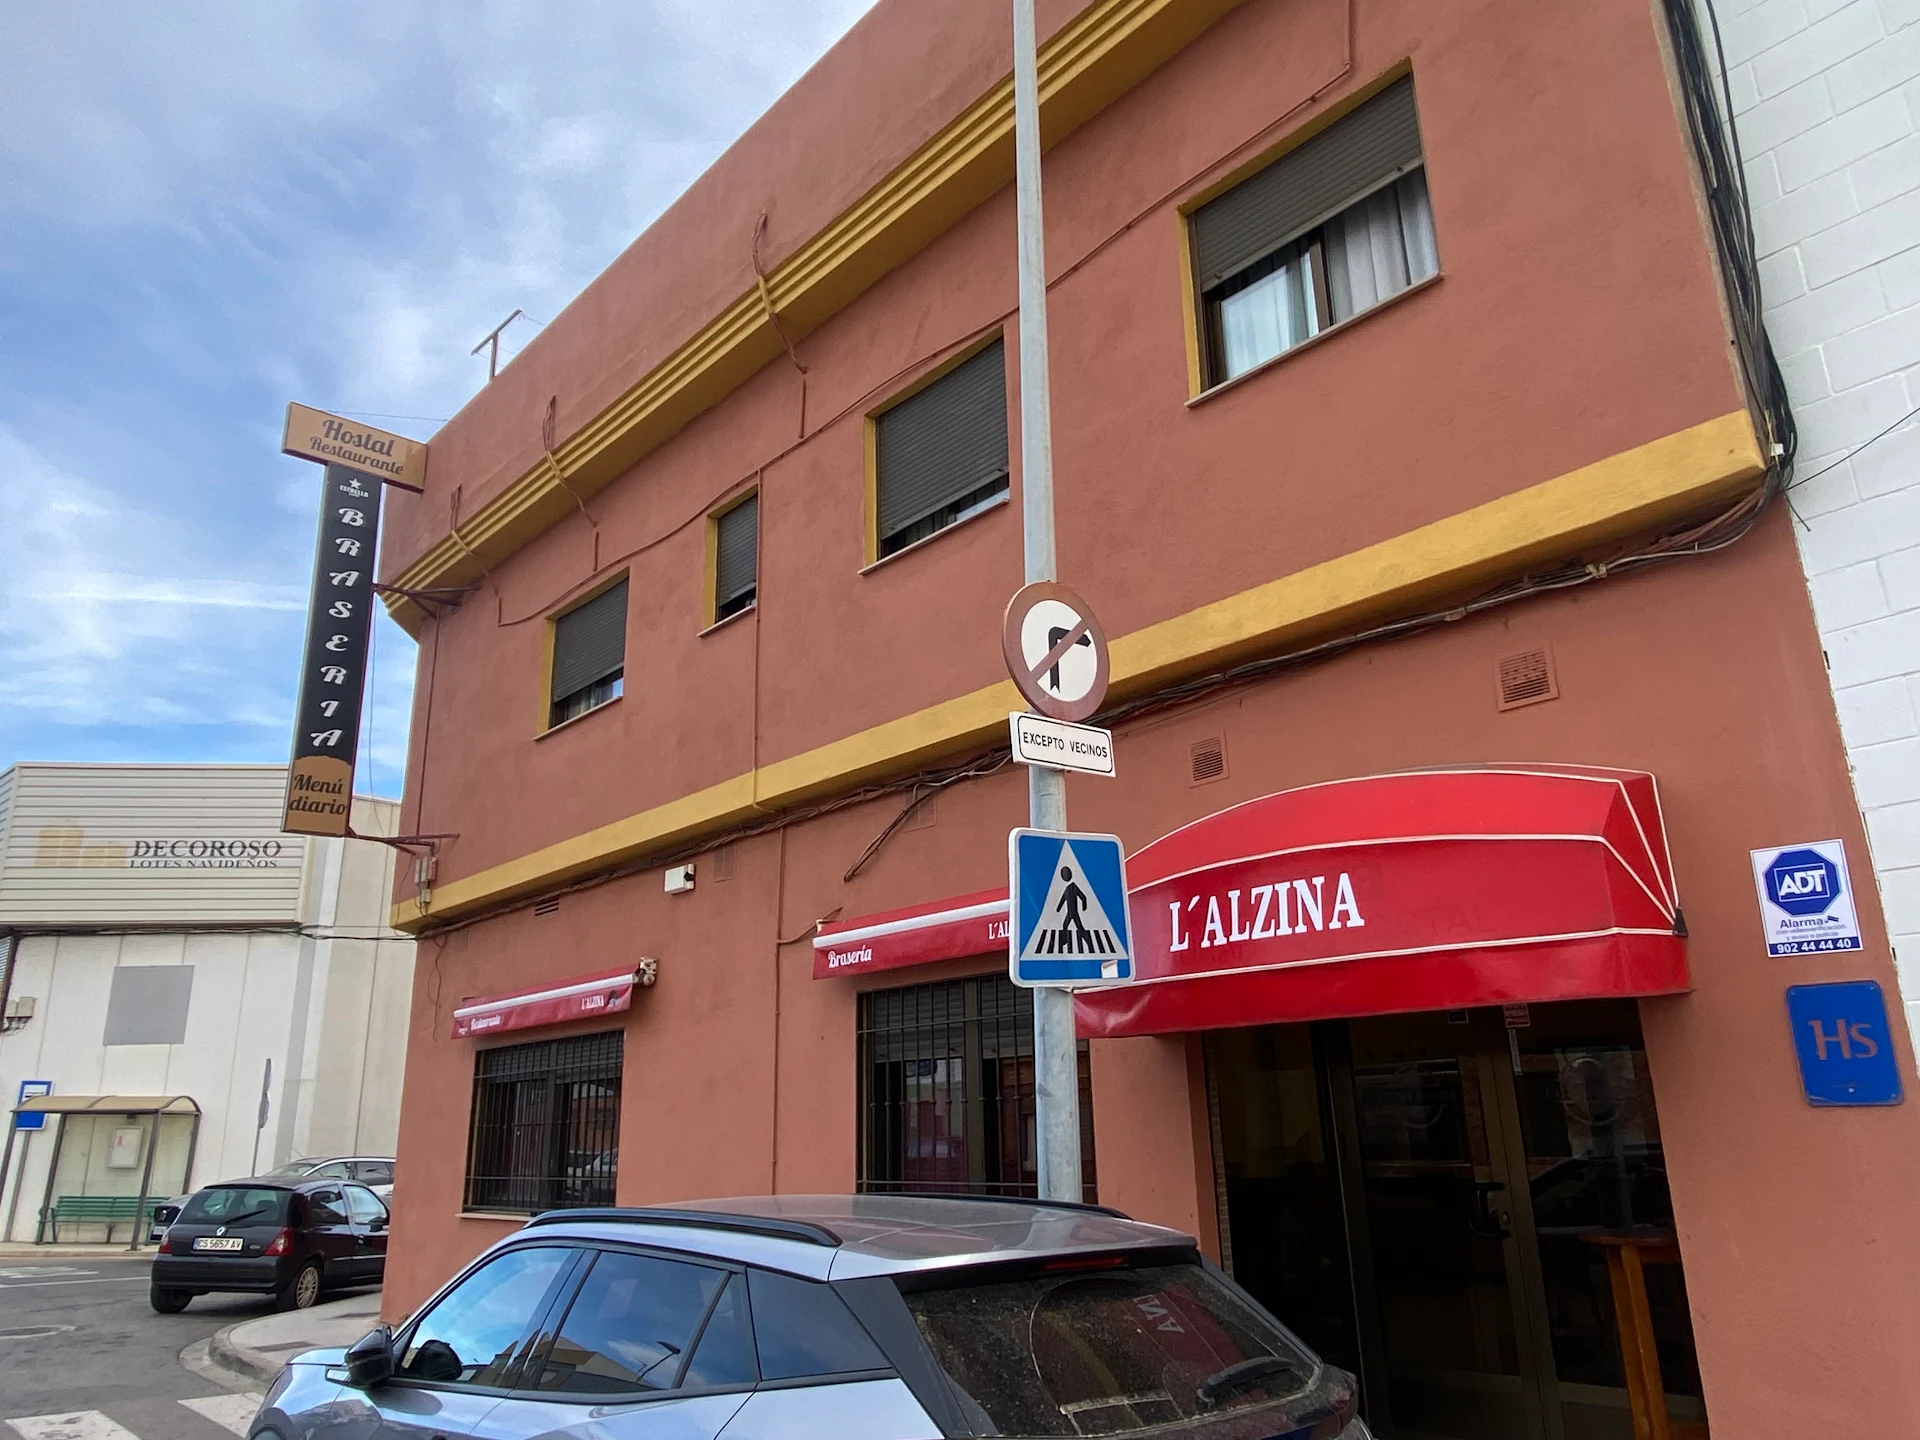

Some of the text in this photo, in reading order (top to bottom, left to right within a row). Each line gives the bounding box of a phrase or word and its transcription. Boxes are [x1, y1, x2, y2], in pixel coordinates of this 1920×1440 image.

[322, 419, 395, 457] Hostal
[309, 436, 404, 475] Restaurante
[310, 507, 364, 748] BRASERIA
[1023, 732, 1108, 758] EXCEPTO VECINOS
[293, 774, 344, 795] Menú
[289, 796, 346, 816] diario
[133, 840, 282, 857] DECOROSO
[130, 859, 181, 868] LOTES
[1778, 870, 1826, 897] ADT
[1780, 918, 1824, 929] Alarma
[1777, 938, 1852, 954] 902 44 44 40
[199, 1239, 208, 1247] CS
[210, 1239, 230, 1248] 5657
[230, 1240, 241, 1248] AV
